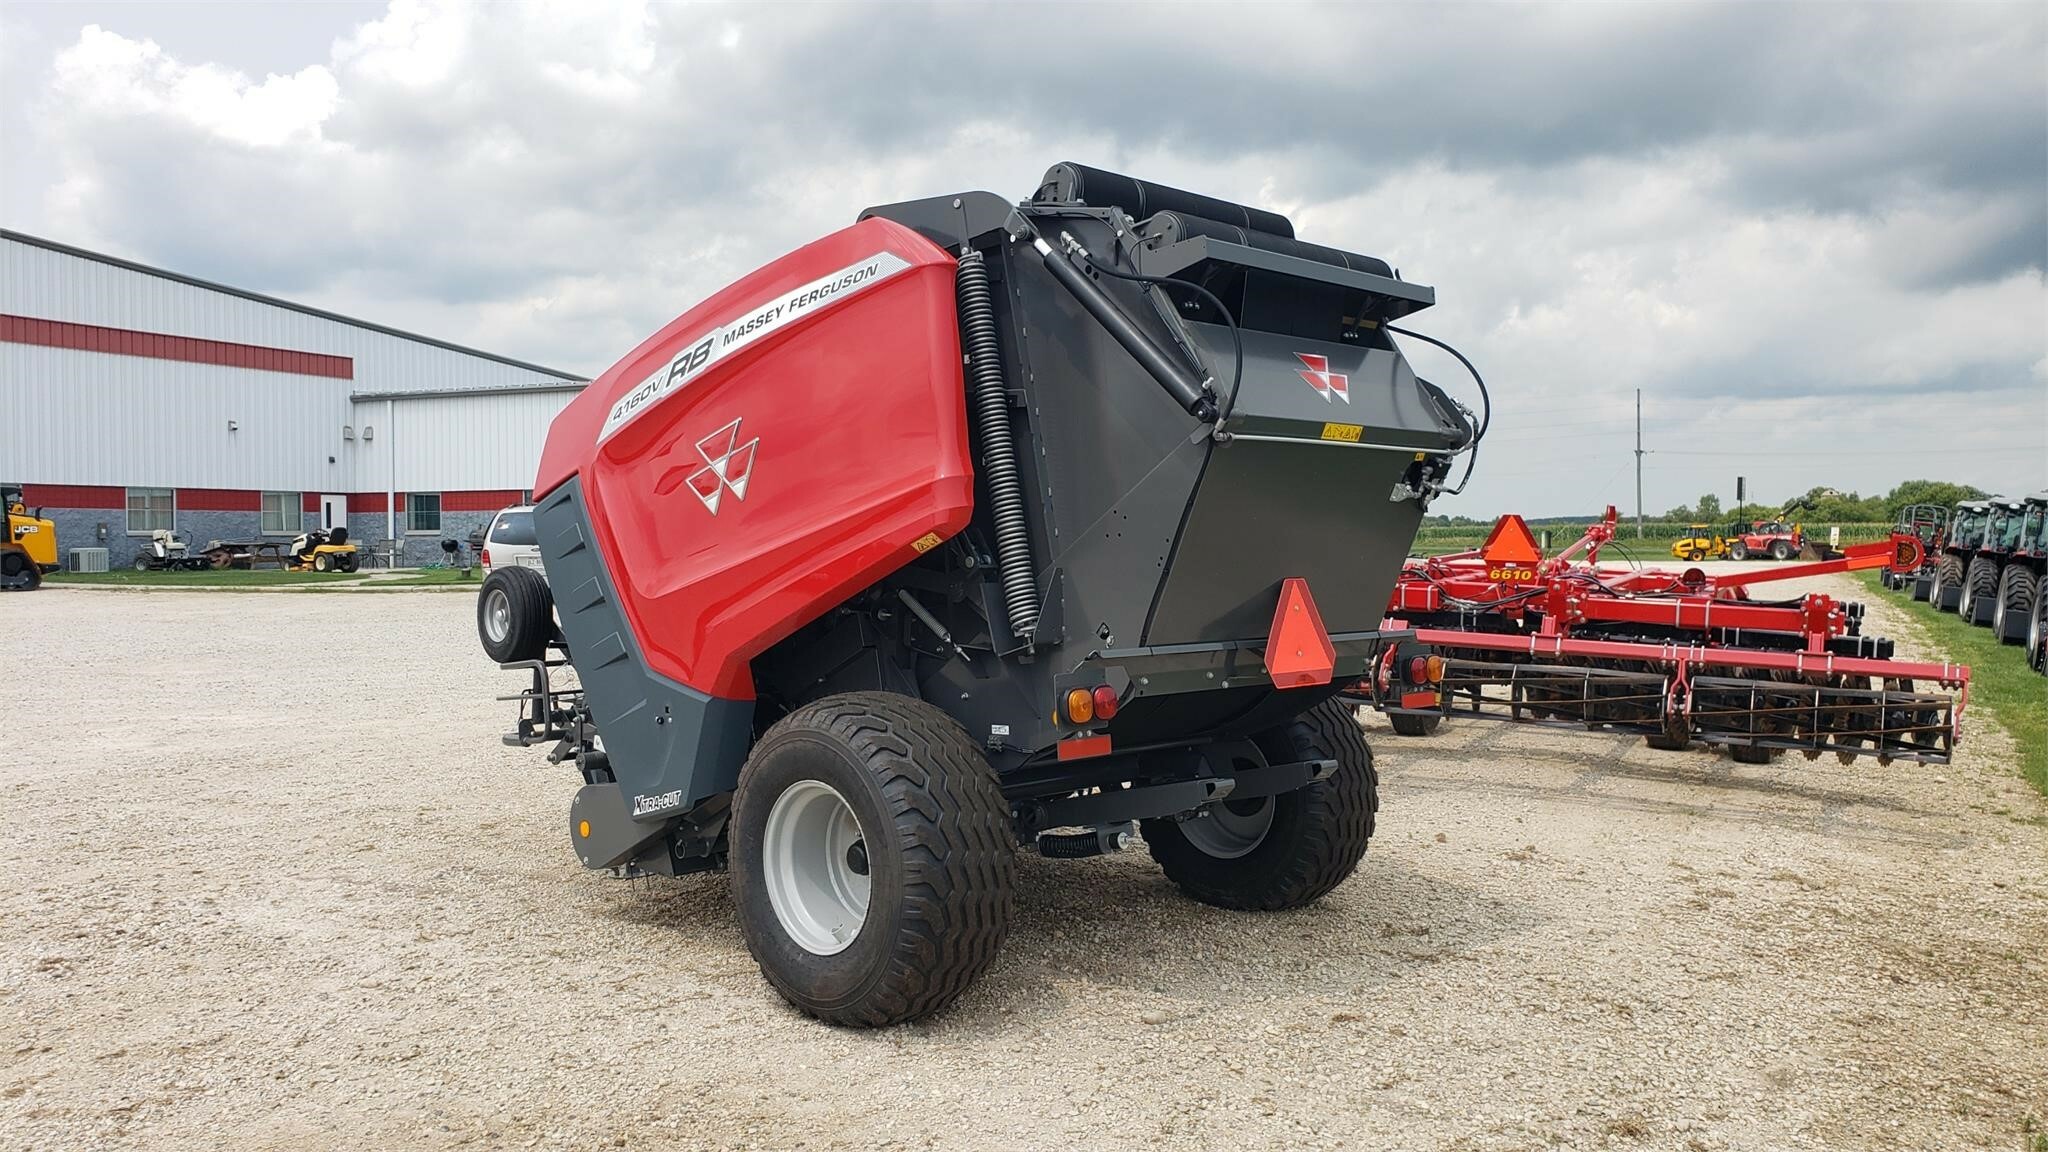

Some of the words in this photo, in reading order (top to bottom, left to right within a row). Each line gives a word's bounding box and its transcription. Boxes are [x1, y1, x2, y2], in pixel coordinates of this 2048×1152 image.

[613, 376, 664, 421] 4160V
[722, 304, 785, 347] MASSEY
[788, 263, 879, 313] FERGUSON
[14, 525, 39, 533] JCB
[1490, 569, 1532, 580] 6610
